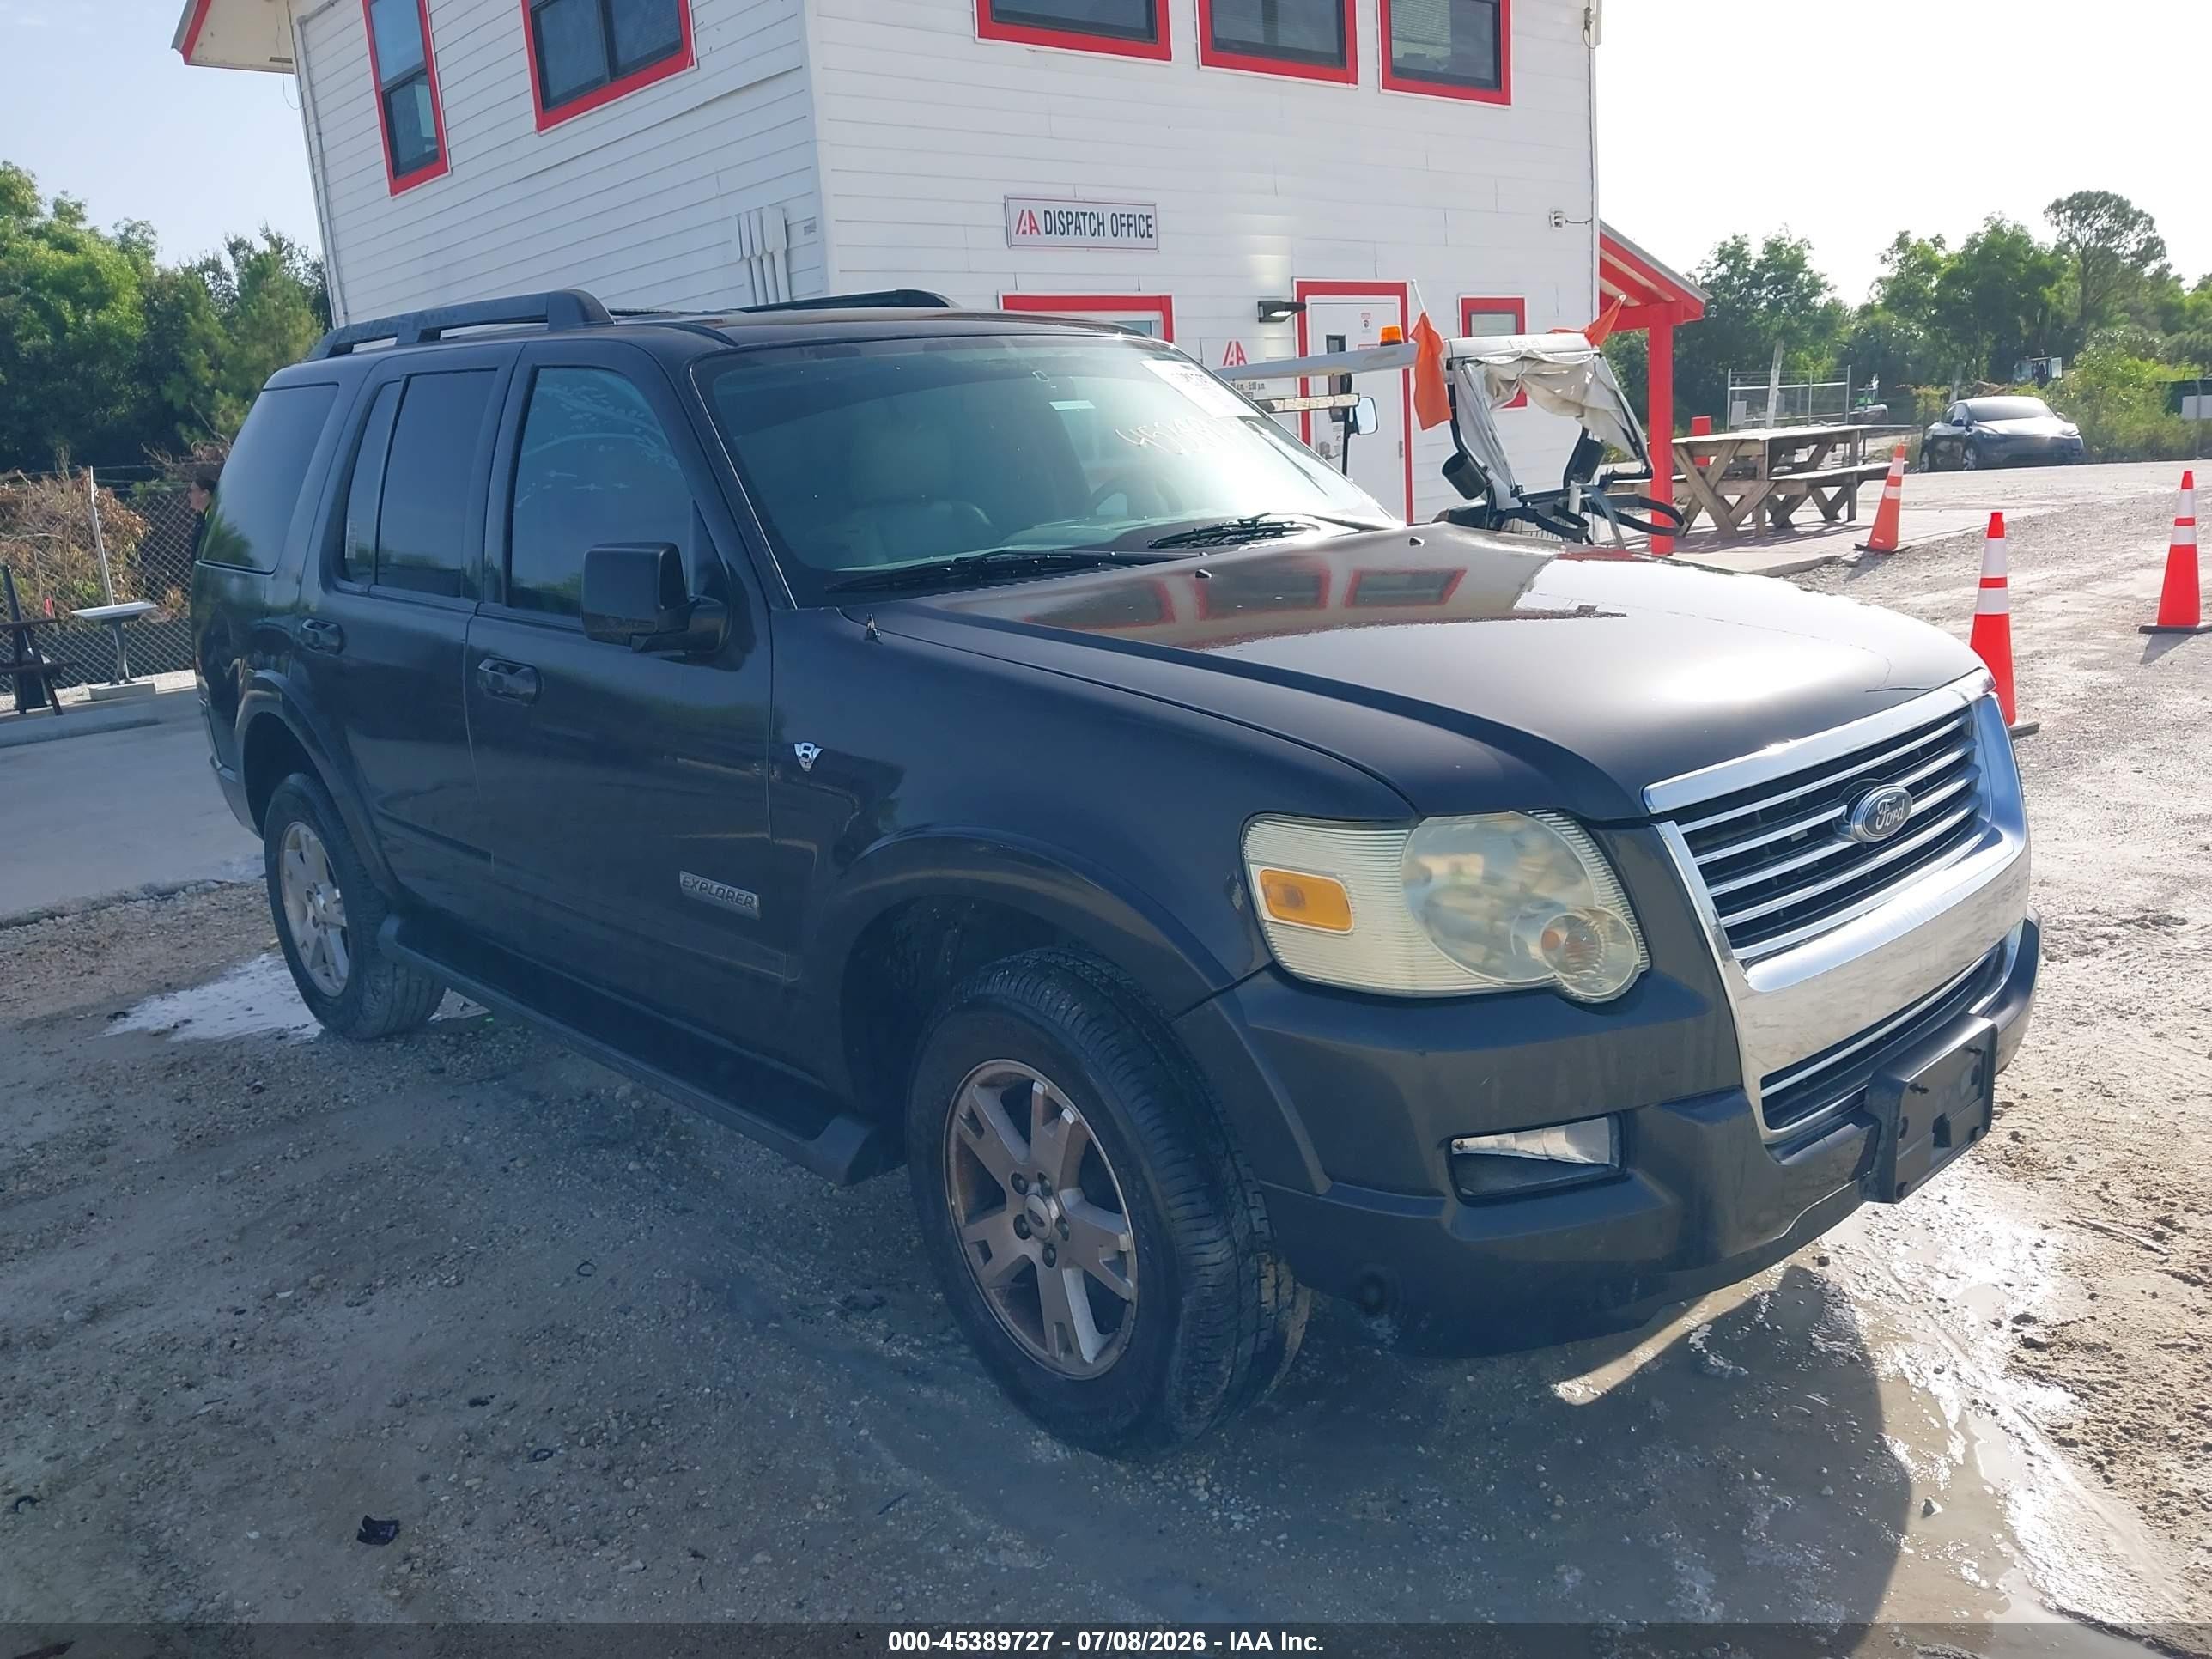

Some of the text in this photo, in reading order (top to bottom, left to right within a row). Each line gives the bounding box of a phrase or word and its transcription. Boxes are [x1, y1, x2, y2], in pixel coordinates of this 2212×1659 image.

[1043, 210, 1106, 237] DISPATCH
[1110, 212, 1153, 239] OFFICE
[1875, 796, 1905, 831] Ford
[682, 875, 756, 909] EXPLORER
